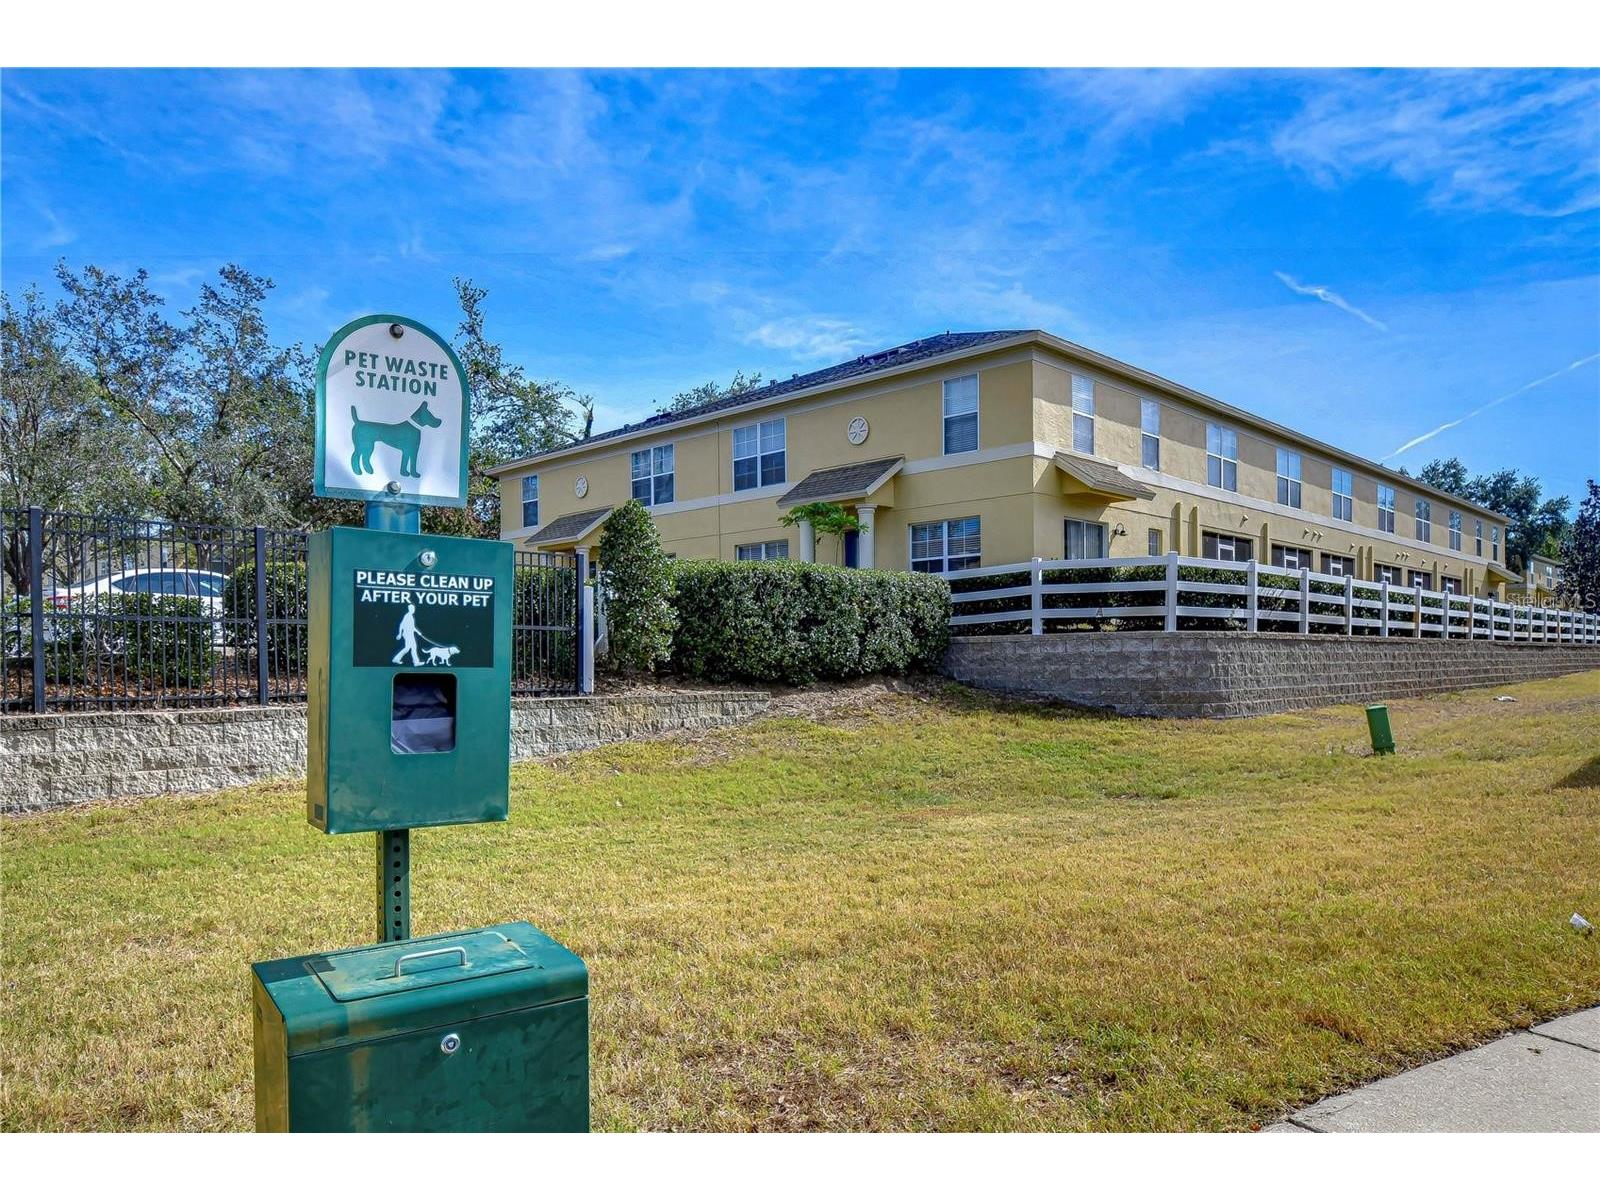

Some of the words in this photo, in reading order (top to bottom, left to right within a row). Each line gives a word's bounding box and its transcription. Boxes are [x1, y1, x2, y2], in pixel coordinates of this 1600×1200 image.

[344, 350, 379, 369] PET
[385, 356, 448, 380] WASTE
[355, 370, 437, 396] STATION
[356, 571, 416, 586] PLEASE
[420, 575, 469, 589] CLEAN
[473, 578, 493, 591] UP
[361, 589, 412, 604] AFTER
[415, 592, 459, 606] YOUR
[463, 594, 490, 607] PET
